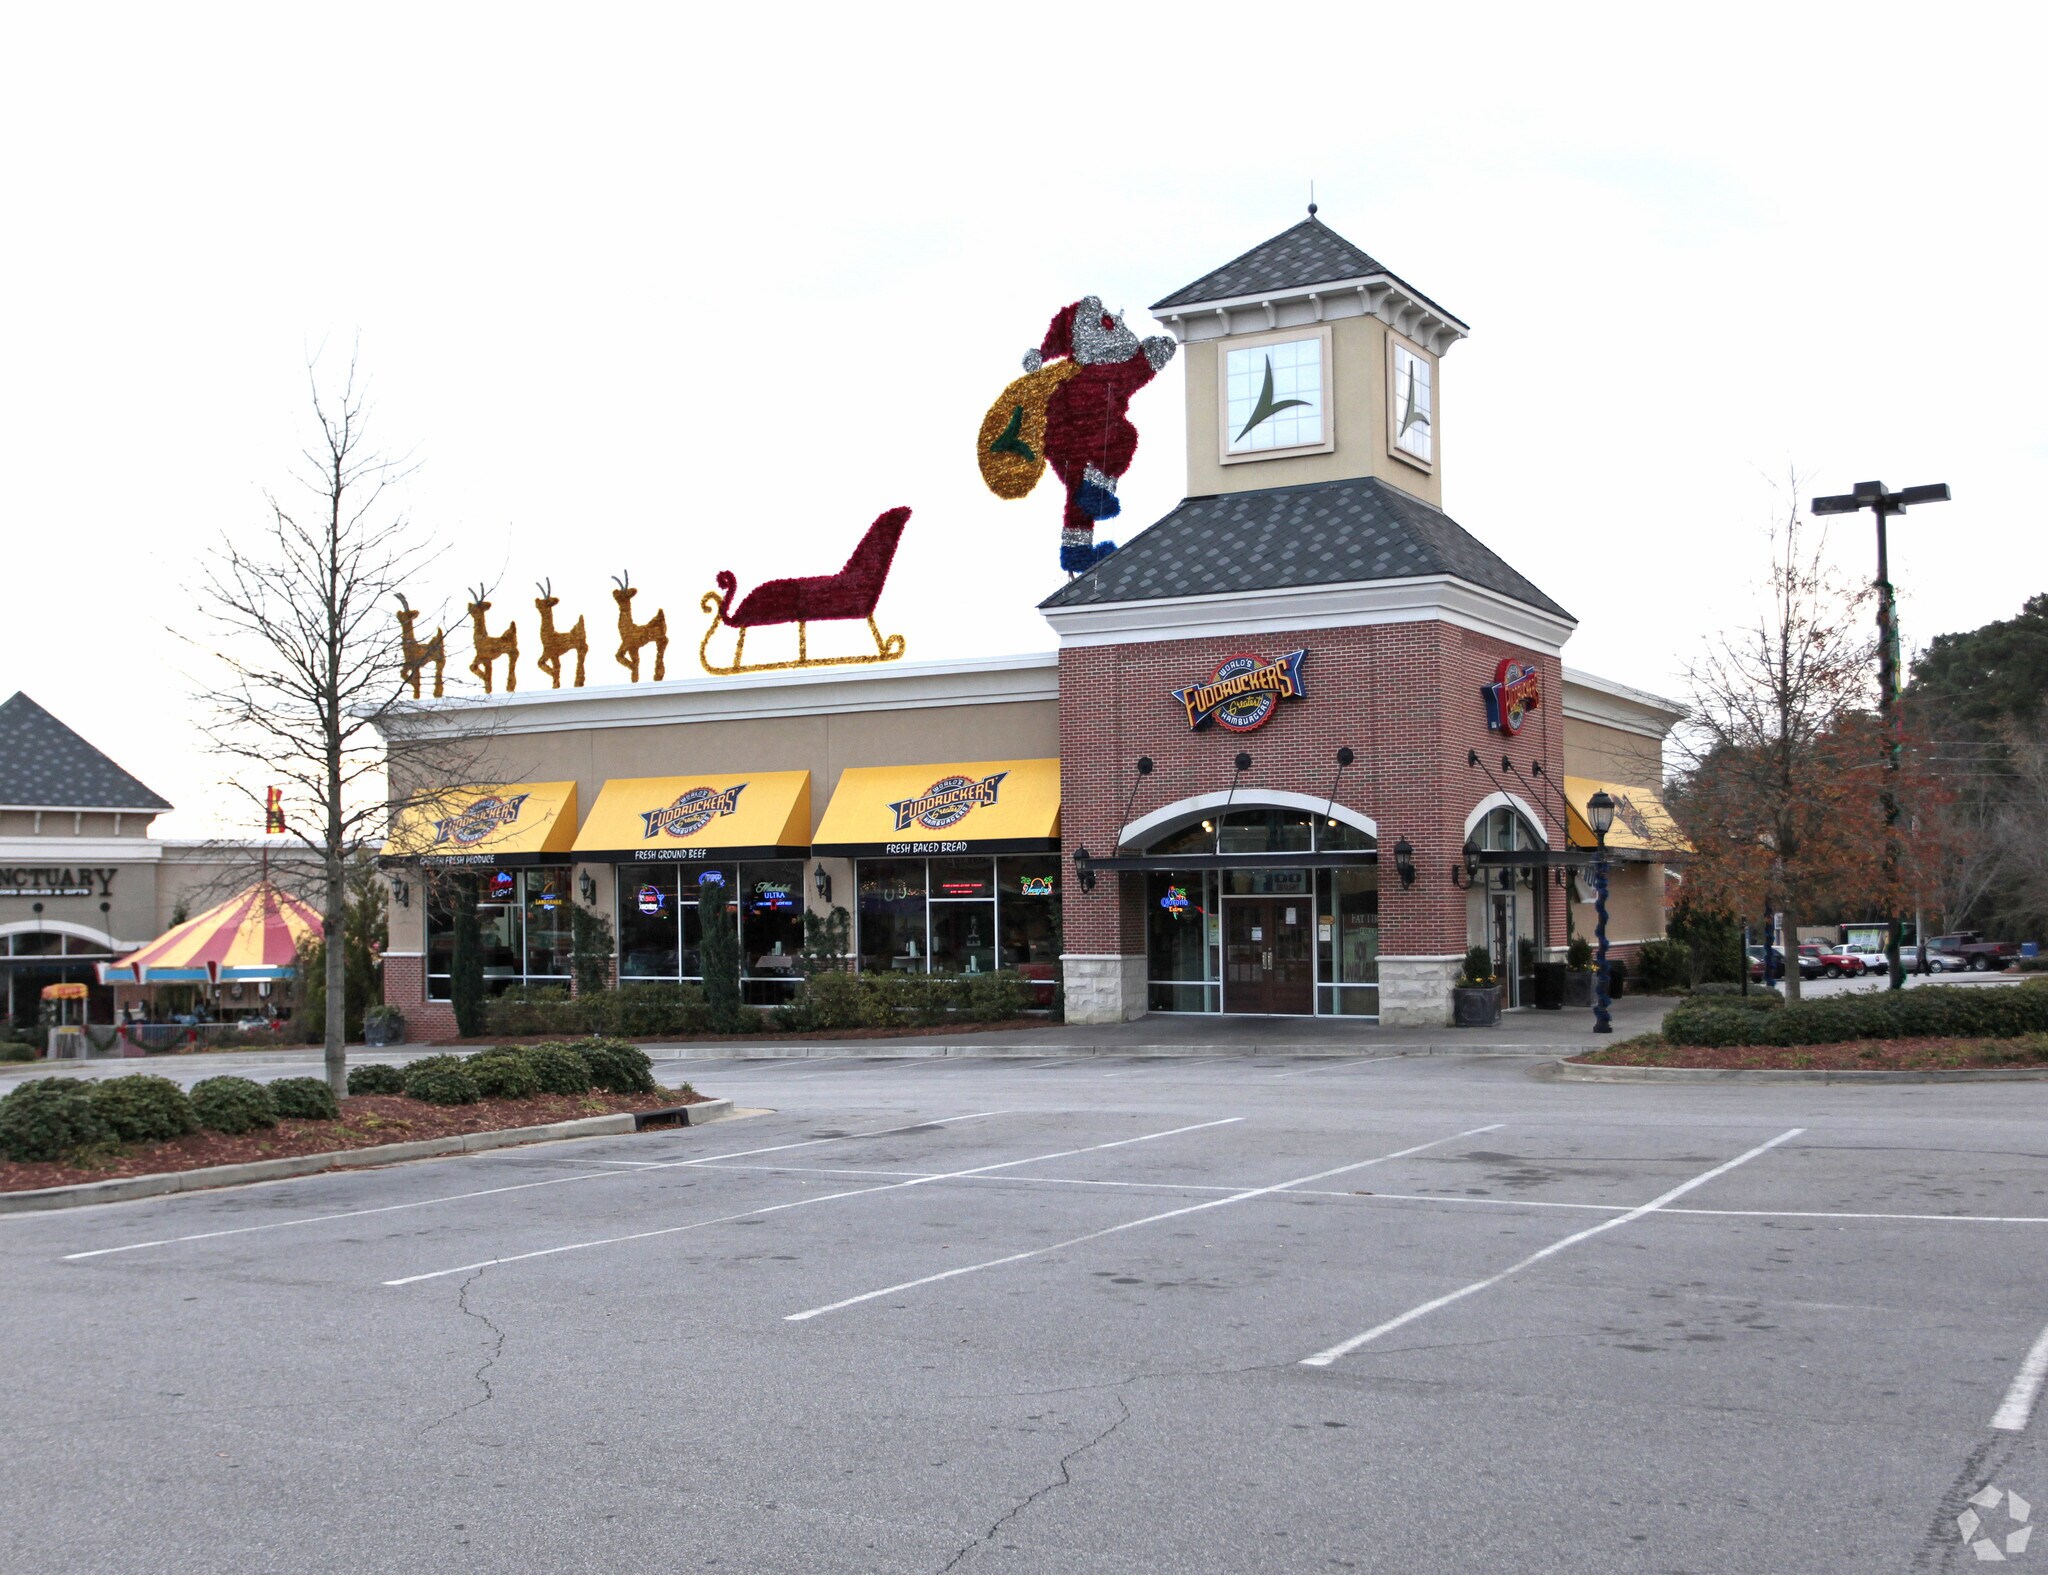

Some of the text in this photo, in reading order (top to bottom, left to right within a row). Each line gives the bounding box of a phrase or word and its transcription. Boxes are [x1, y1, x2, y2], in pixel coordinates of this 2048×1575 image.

[1219, 658, 1253, 677] WORLD'S
[1183, 659, 1293, 728] FUDDRUCKERS
[1220, 699, 1270, 726] HAMBURGERS
[1228, 695, 1263, 715] Greatest
[931, 778, 965, 793] WORLD'S
[679, 789, 709, 804] WORLD'S
[898, 778, 996, 829] FUDDRUCKERS
[436, 798, 519, 843] FUDDRUCKERS
[648, 790, 737, 836] FUDDRUCKERS
[923, 805, 969, 827] HAMBURGERS
[669, 816, 711, 835] HAMBURGERS
[635, 849, 707, 860] FRESH GROUND BEEF
[886, 841, 968, 854] FRESH BAKED BREAD
[445, 855, 465, 865] FRESH
[465, 854, 495, 864] PRODUCE
[491, 887, 513, 898] LIGHT
[1160, 897, 1189, 908] Corona
